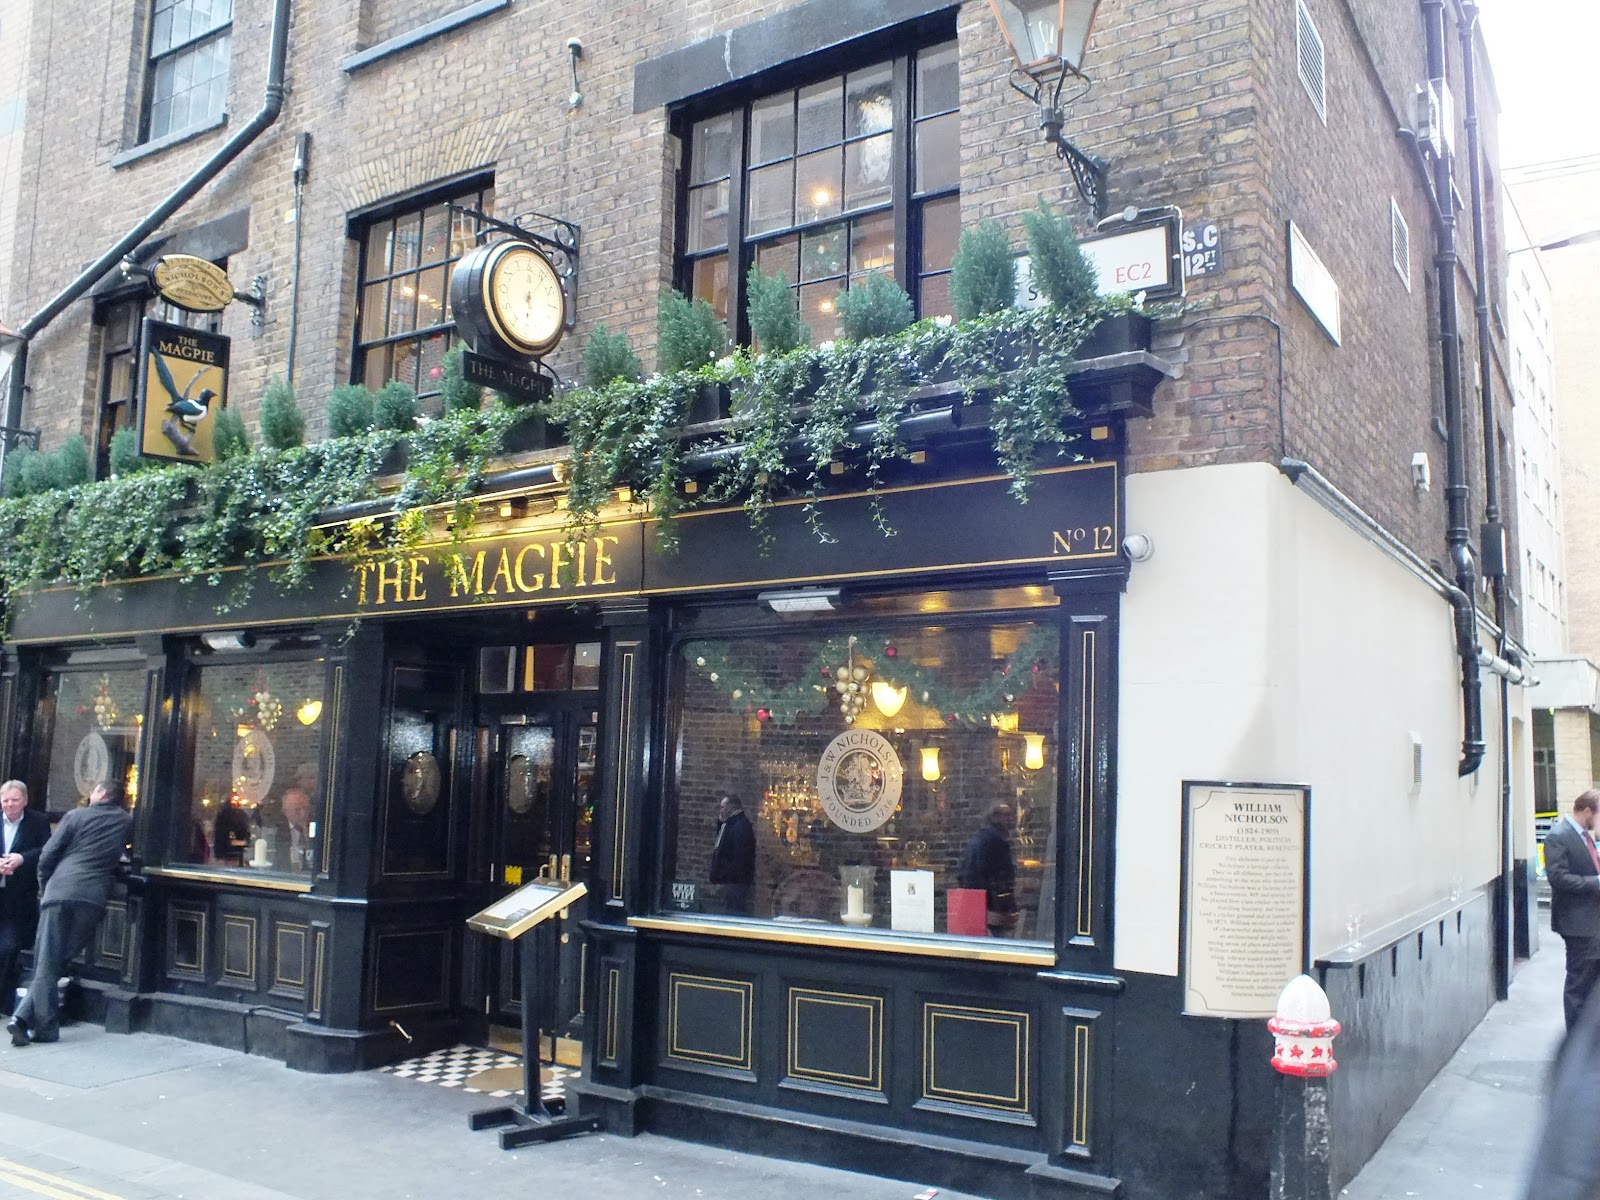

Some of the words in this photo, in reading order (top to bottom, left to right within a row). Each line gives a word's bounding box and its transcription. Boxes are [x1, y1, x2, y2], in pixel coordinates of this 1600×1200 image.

[1116, 262, 1152, 284] EC2
[178, 335, 198, 347] THE
[159, 340, 215, 362] MAGPIE
[470, 360, 496, 380] THE
[1093, 525, 1112, 550] 12
[354, 555, 430, 605] THE
[450, 536, 618, 598] MAGPIE
[825, 750, 836, 762] W
[825, 795, 871, 827] FOUNDED
[875, 799, 894, 819] 1736
[1234, 803, 1282, 813] WILLIAM
[1224, 813, 1289, 824] NICHOLSON
[1199, 842, 1232, 850] CRICKET
[672, 883, 695, 891] FREE
